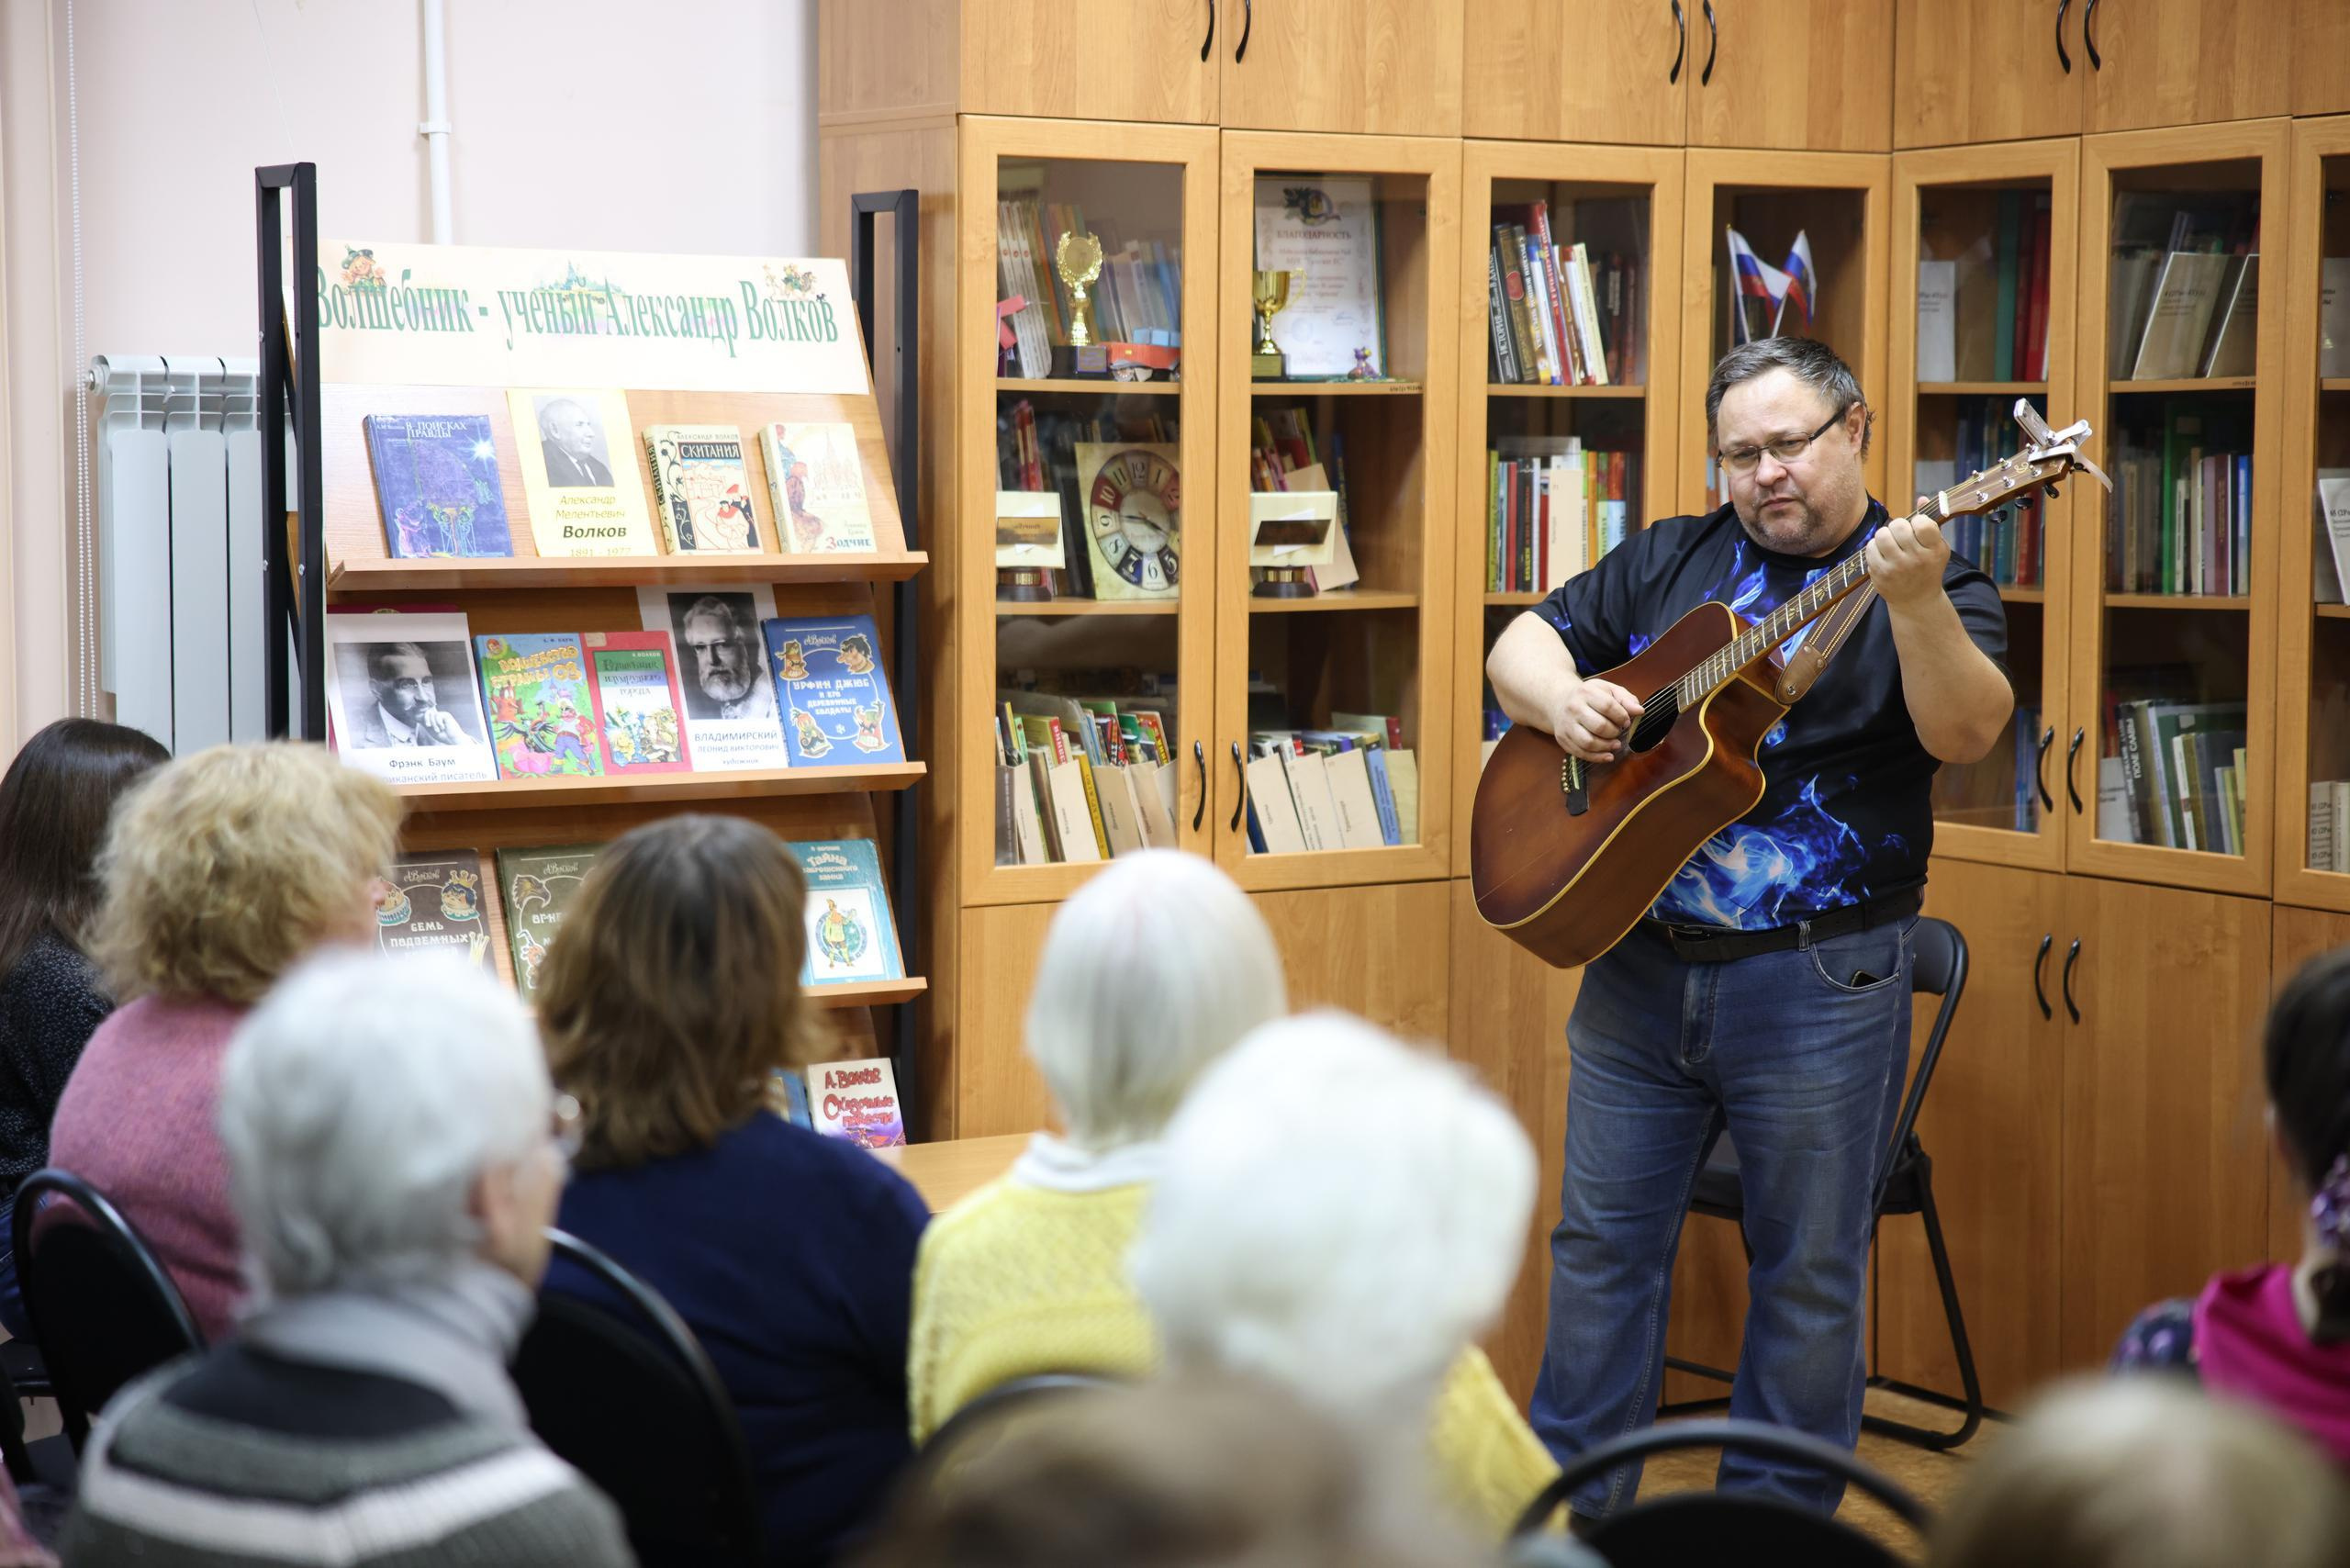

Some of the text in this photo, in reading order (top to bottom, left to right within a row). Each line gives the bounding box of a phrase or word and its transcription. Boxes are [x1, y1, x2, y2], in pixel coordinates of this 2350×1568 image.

[319, 266, 474, 332] Волшебник
[605, 276, 738, 357] Александр
[740, 281, 839, 342] Волков
[418, 421, 468, 431] ПОИСКАХ
[407, 429, 452, 439] ПРАВДЫ
[681, 444, 740, 458] СКИТАНИЯ
[560, 495, 616, 506] Александр
[556, 510, 625, 520] Мелентьевич
[563, 525, 627, 538] Волков
[695, 730, 778, 742] ВЛАДИМИРСКИЙ
[389, 757, 456, 769] Фрэнк Баум
[411, 921, 444, 932] СЕМЬ
